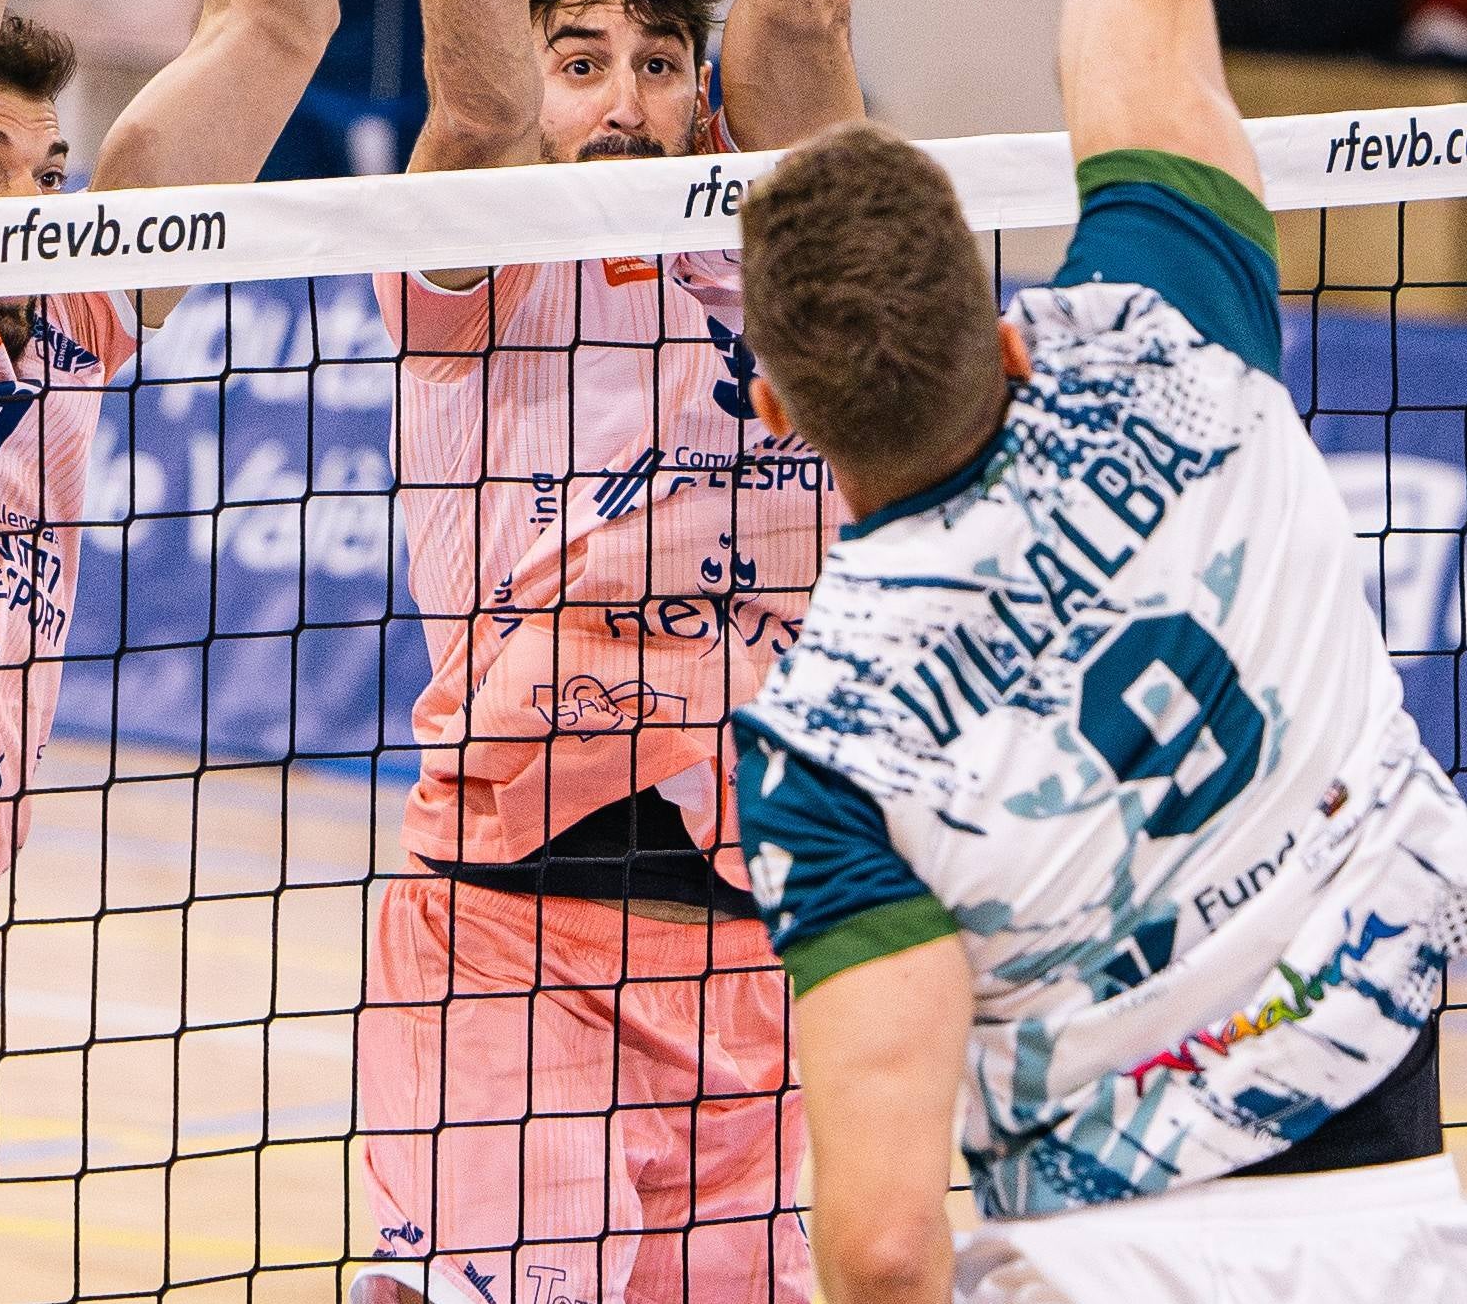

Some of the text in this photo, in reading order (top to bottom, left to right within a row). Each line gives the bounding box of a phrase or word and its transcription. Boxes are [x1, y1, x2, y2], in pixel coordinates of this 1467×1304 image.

[0, 204, 228, 264] rfevb.com
[890, 414, 1204, 747] VILLALBA
[1077, 611, 1266, 840] 9
